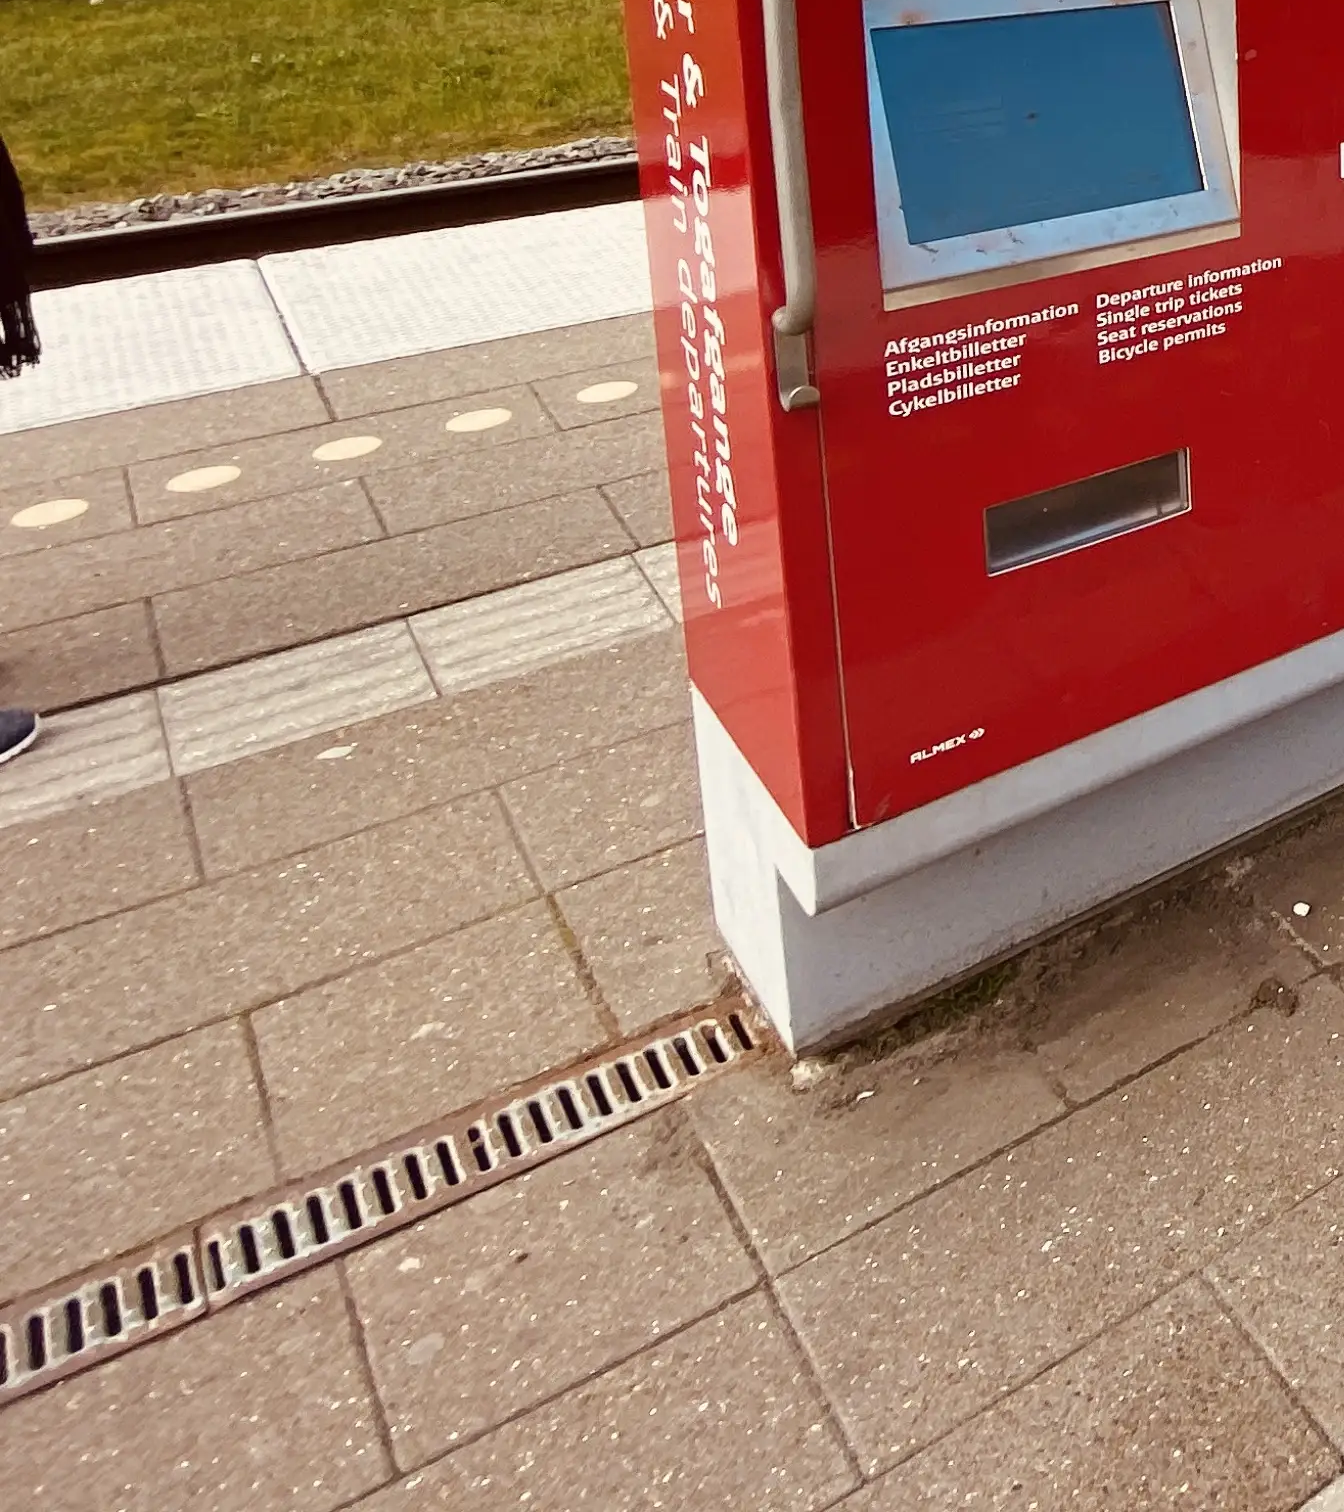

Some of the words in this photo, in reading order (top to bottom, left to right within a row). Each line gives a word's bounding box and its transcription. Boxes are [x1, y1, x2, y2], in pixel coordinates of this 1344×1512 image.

[682, 52, 705, 108] &
[1096, 279, 1184, 309] Departure
[1188, 257, 1282, 287] information
[1096, 302, 1150, 327] Single
[1155, 296, 1185, 314] trip
[1189, 283, 1242, 306] tickets
[660, 74, 689, 234] Train
[677, 258, 722, 609] departures
[688, 135, 738, 547] Togafgange
[885, 303, 1079, 355] Afgangsinformation
[1097, 324, 1137, 346] Seat
[1141, 300, 1243, 335] reservations
[1098, 337, 1158, 364] Bicycle
[1163, 321, 1226, 351] permits
[886, 333, 1027, 377] Enkeltbilletter
[887, 353, 1021, 397] Pladsbilletter
[889, 373, 1021, 417] Cykelbilletter
[910, 734, 966, 765] ALMEX
